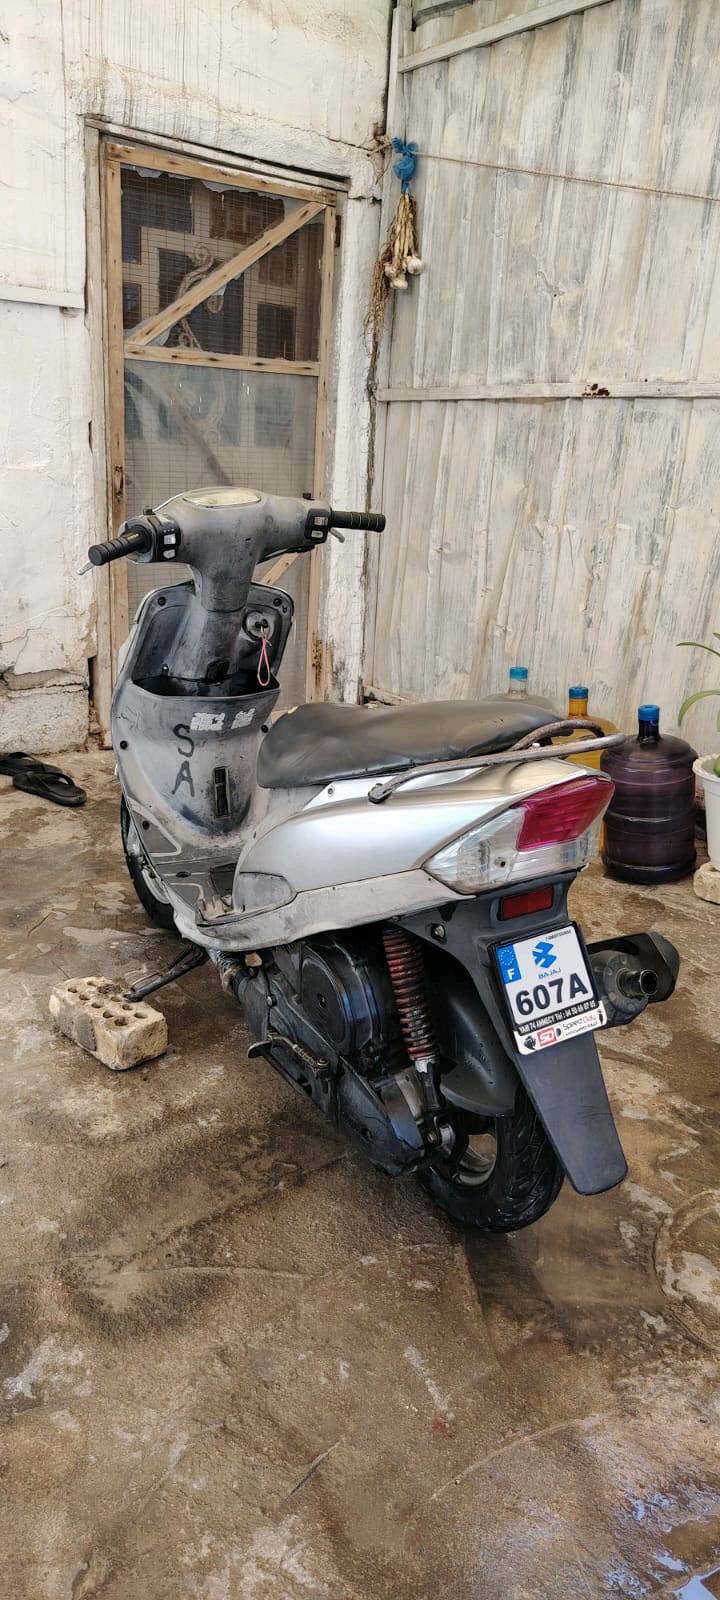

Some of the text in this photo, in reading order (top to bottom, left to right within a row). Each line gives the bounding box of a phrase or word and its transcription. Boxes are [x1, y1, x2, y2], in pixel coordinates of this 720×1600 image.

[507, 968, 514, 980] F
[538, 967, 562, 980] BAJAJ
[516, 973, 588, 1016] 607A
[563, 1018, 581, 1030] Speed
